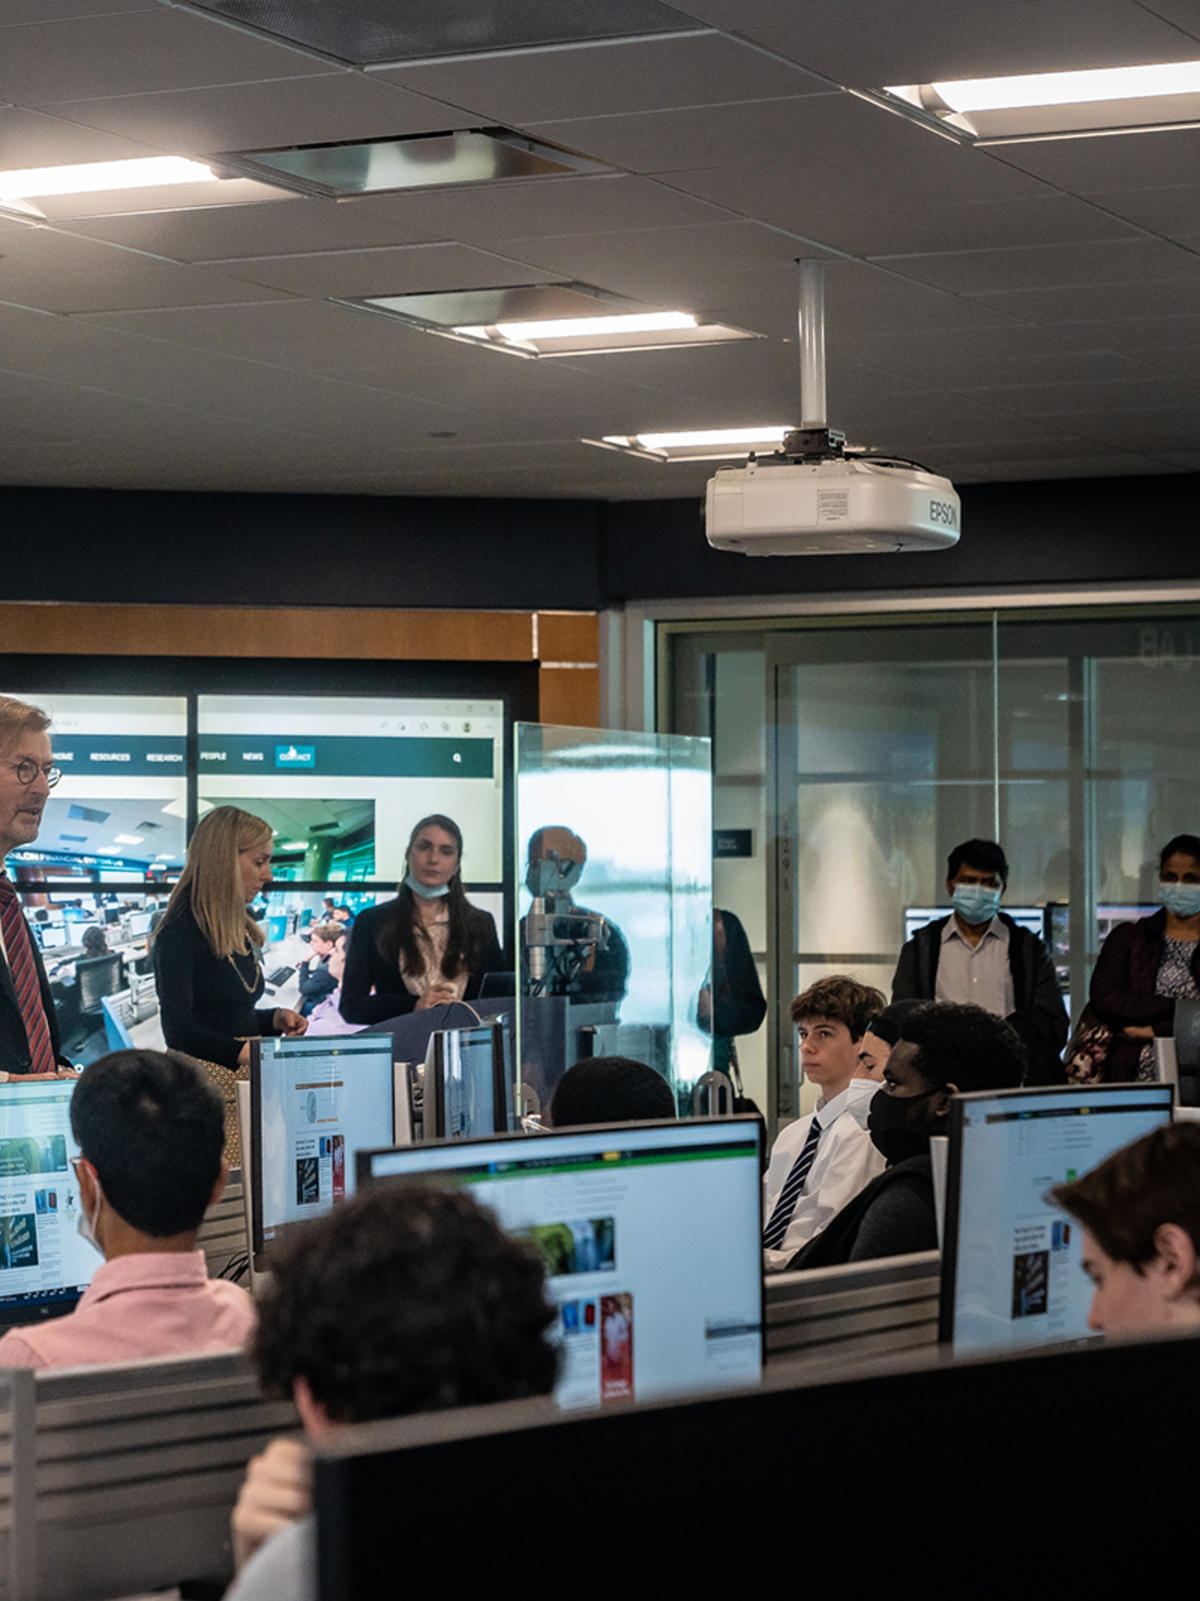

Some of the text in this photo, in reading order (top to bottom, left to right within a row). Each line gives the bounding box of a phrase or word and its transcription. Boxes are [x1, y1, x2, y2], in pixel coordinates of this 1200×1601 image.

[930, 500, 958, 526] EPSON
[200, 752, 227, 761] PEOPLE
[242, 752, 263, 761] NEWS
